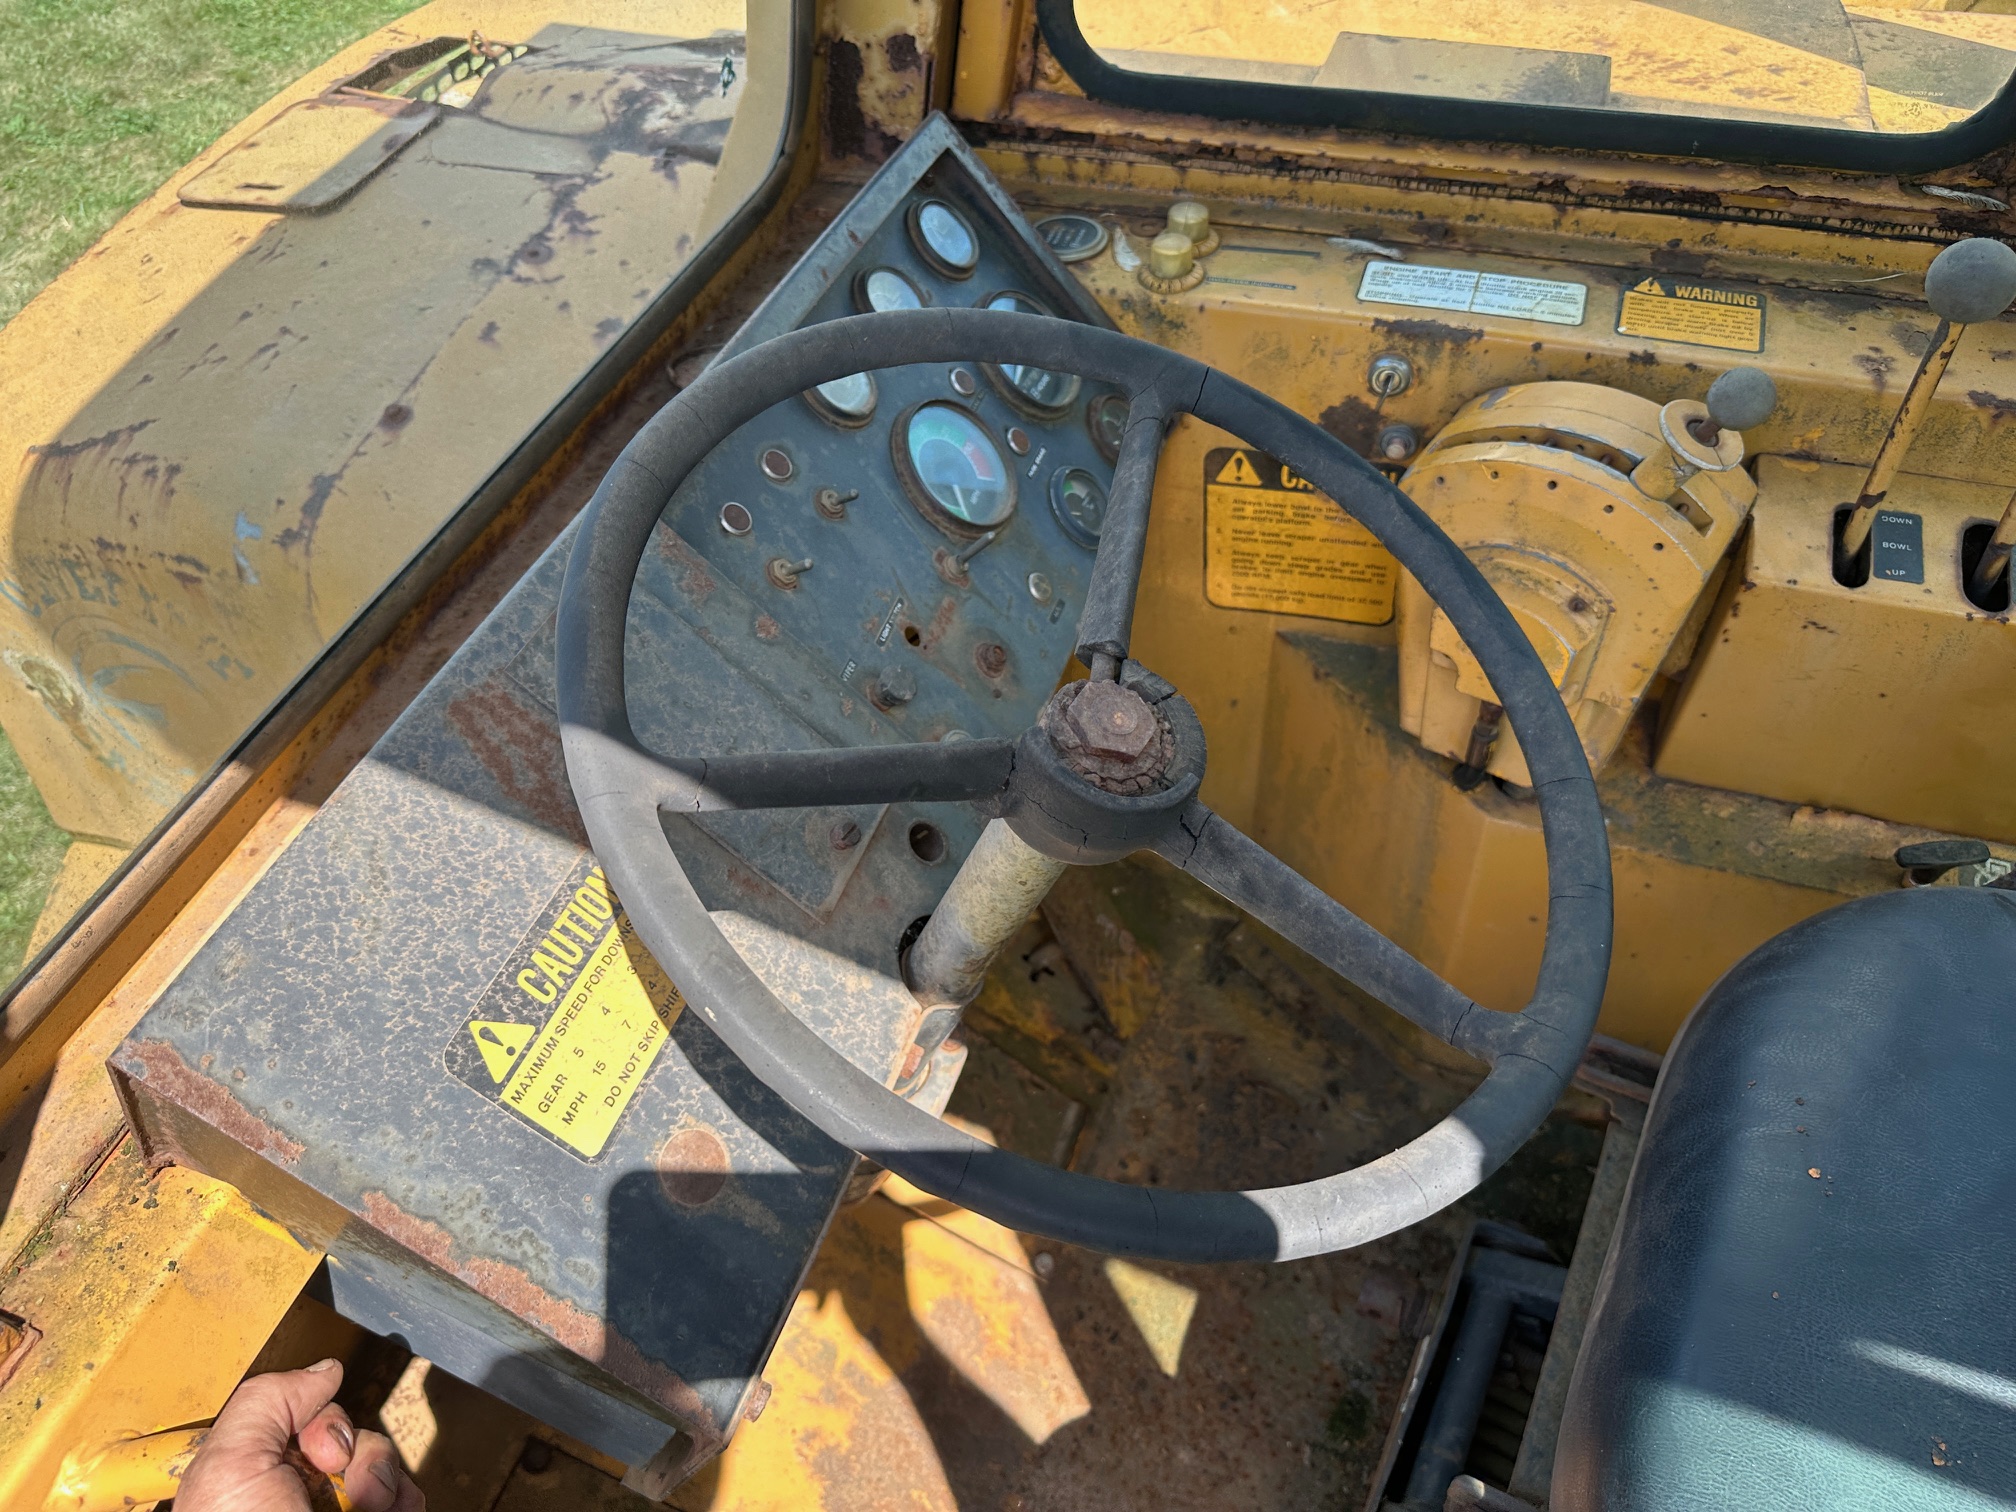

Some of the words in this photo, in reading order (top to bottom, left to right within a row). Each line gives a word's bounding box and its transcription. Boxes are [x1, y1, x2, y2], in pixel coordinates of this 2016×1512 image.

[1674, 285, 1757, 307] WARNING
[1881, 516, 1912, 525] DOWN
[1882, 542, 1912, 551] BOWL
[510, 1036, 560, 1104] MAXIMUM
[554, 992, 588, 1036] SPEED
[584, 965, 606, 994] FOR
[538, 1074, 568, 1114] GEAR
[573, 1046, 584, 1058] 5
[601, 1006, 611, 1016] 4
[626, 965, 638, 975] 3
[562, 1091, 588, 1126] MPH
[592, 1060, 606, 1076] 15
[622, 1018, 632, 1030] 7
[648, 980, 658, 990] 4
[604, 1085, 622, 1108] DO
[622, 1051, 642, 1085] NOT
[638, 1020, 661, 1053] SKIP
[658, 986, 681, 1019] SHIF
